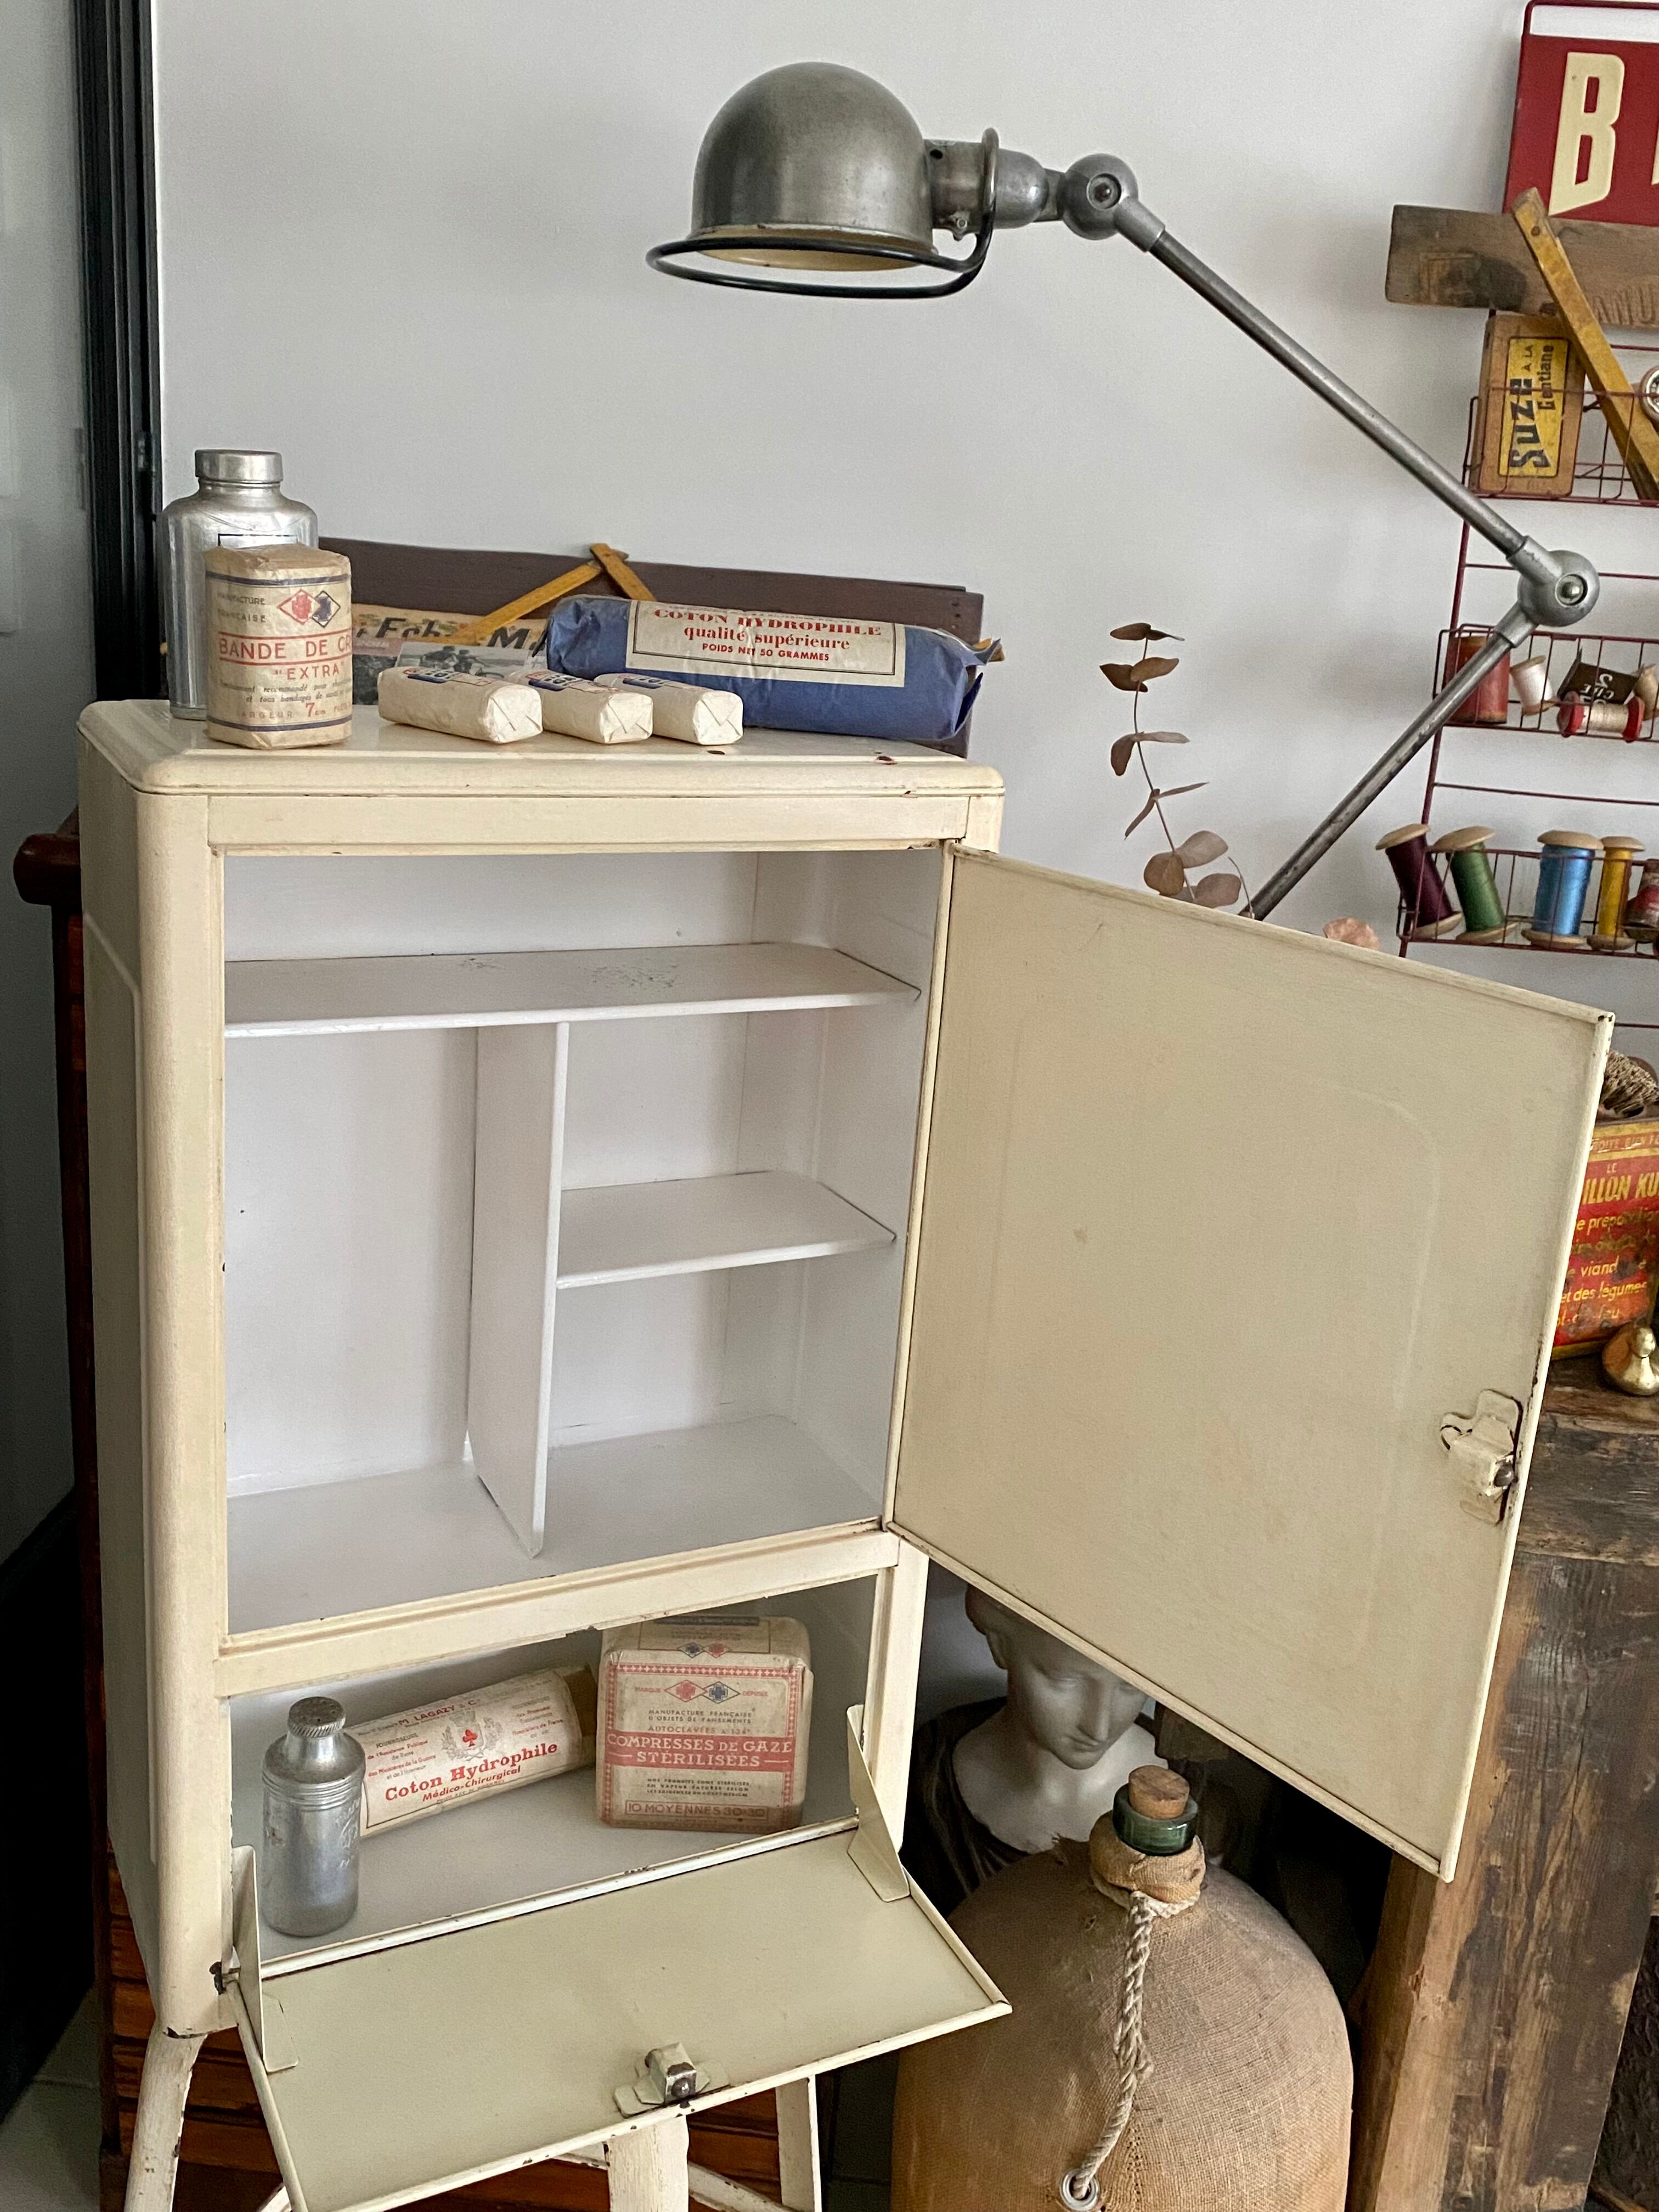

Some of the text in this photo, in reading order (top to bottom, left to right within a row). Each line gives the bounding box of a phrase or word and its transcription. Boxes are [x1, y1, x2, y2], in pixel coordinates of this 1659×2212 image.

[1537, 345, 1556, 410] Gentiane
[654, 609, 728, 623] COTON
[738, 617, 881, 635] HYDROPHILE
[684, 626, 850, 650] qualité supérieure
[220, 638, 287, 659] BANDE
[306, 640, 328, 657] DE
[702, 643, 733, 652] POIDS
[738, 646, 755, 656] NET
[778, 650, 830, 661] GRAMMES
[1607, 1163, 1617, 1173] LE
[1635, 1171, 1659, 1199] KU
[1573, 1285, 1596, 1301] des
[414, 1705, 455, 1721] LAGAZY
[607, 1734, 793, 1753] COMPRESSES DE GAZE
[636, 1750, 760, 1767] STÉRILISÉES
[385, 1776, 443, 1802] Coton
[450, 1742, 558, 1782] Hydrophile
[628, 1803, 642, 1811] 10
[645, 1803, 721, 1815] MOYENNES
